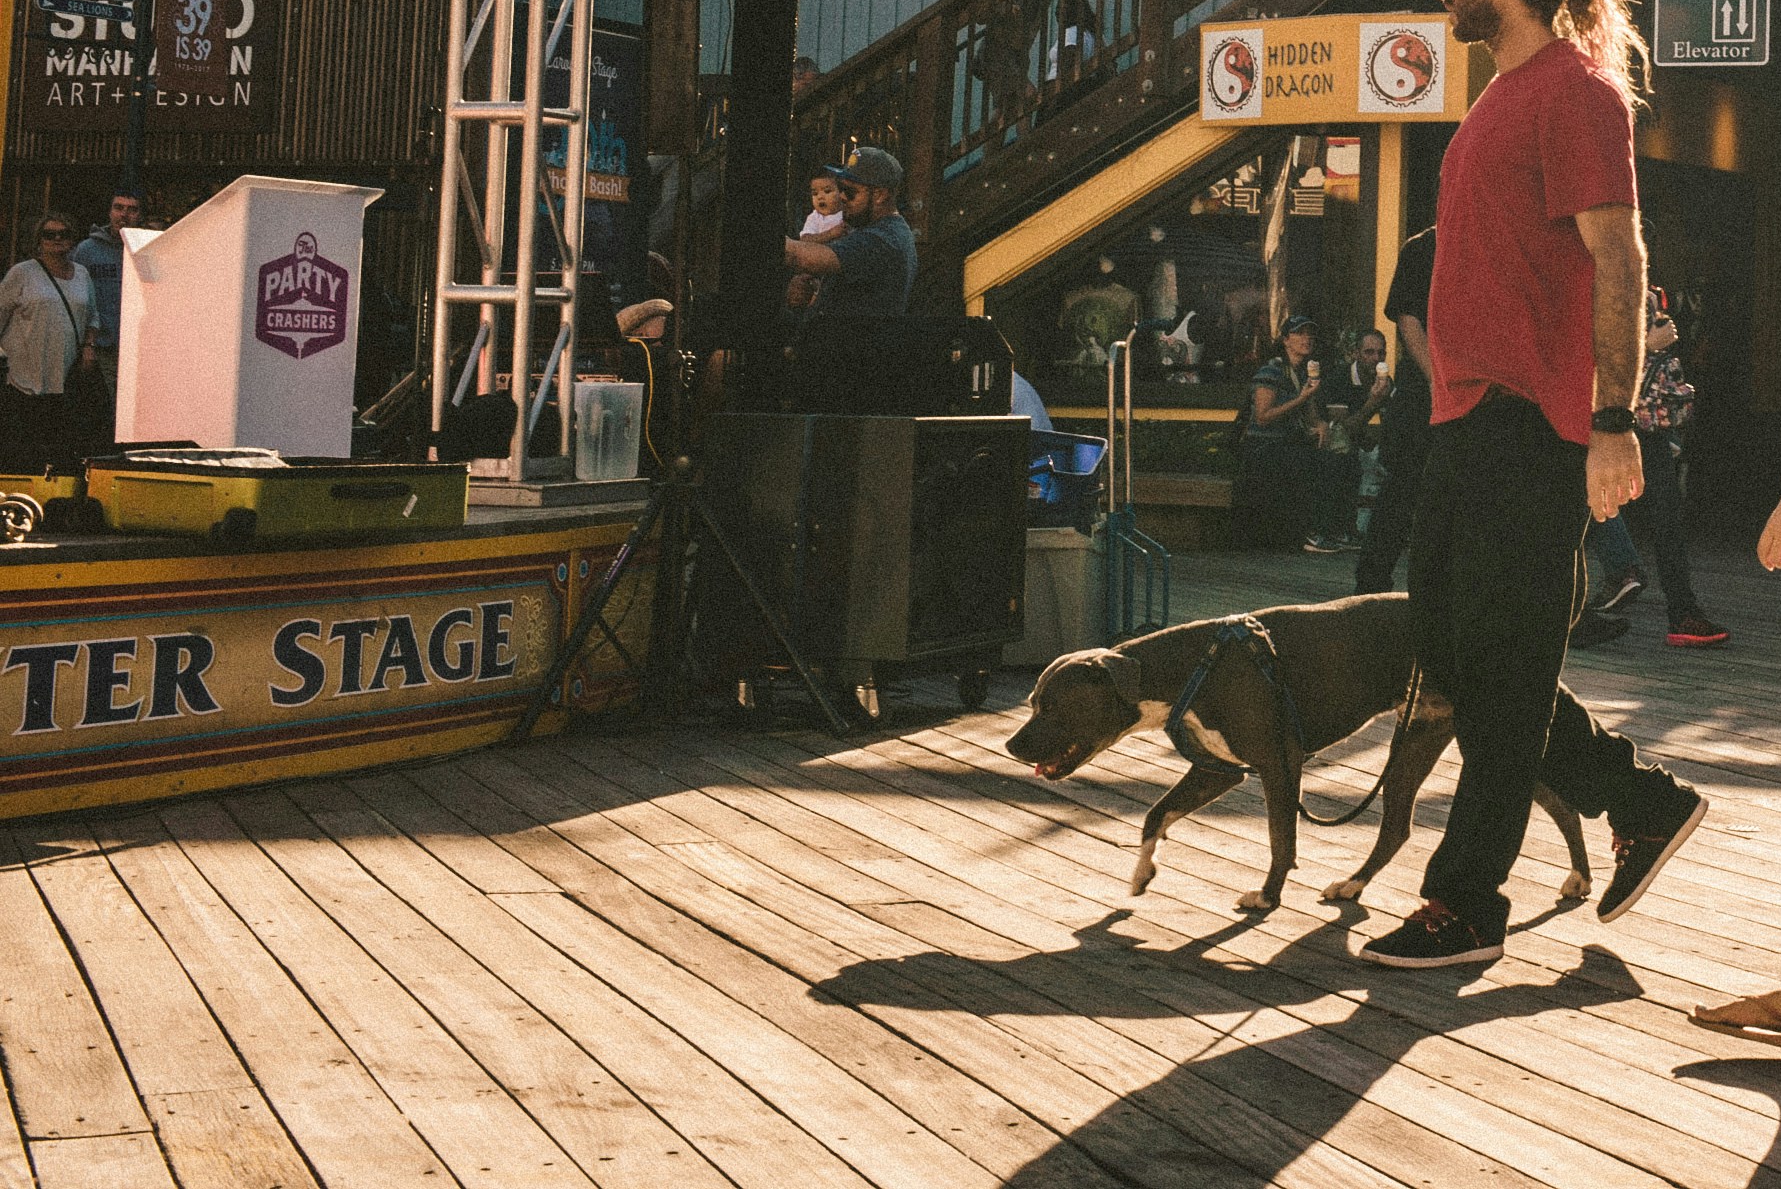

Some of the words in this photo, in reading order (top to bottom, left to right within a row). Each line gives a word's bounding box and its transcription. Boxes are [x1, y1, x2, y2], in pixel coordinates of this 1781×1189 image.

[67, 0, 85, 12] SEA
[87, 2, 114, 17] LIONS
[175, 37, 190, 60] IS
[191, 39, 212, 61] 39
[1268, 41, 1332, 66] HIDDEN
[1673, 41, 1751, 59] Elevator
[46, 82, 106, 106] ART
[1265, 74, 1333, 98] DRAGON
[589, 176, 622, 196] Bash!
[264, 261, 342, 302] PARTY
[266, 312, 337, 330] CRASHERS
[0, 632, 220, 736] TER
[269, 600, 519, 708] STAGE
